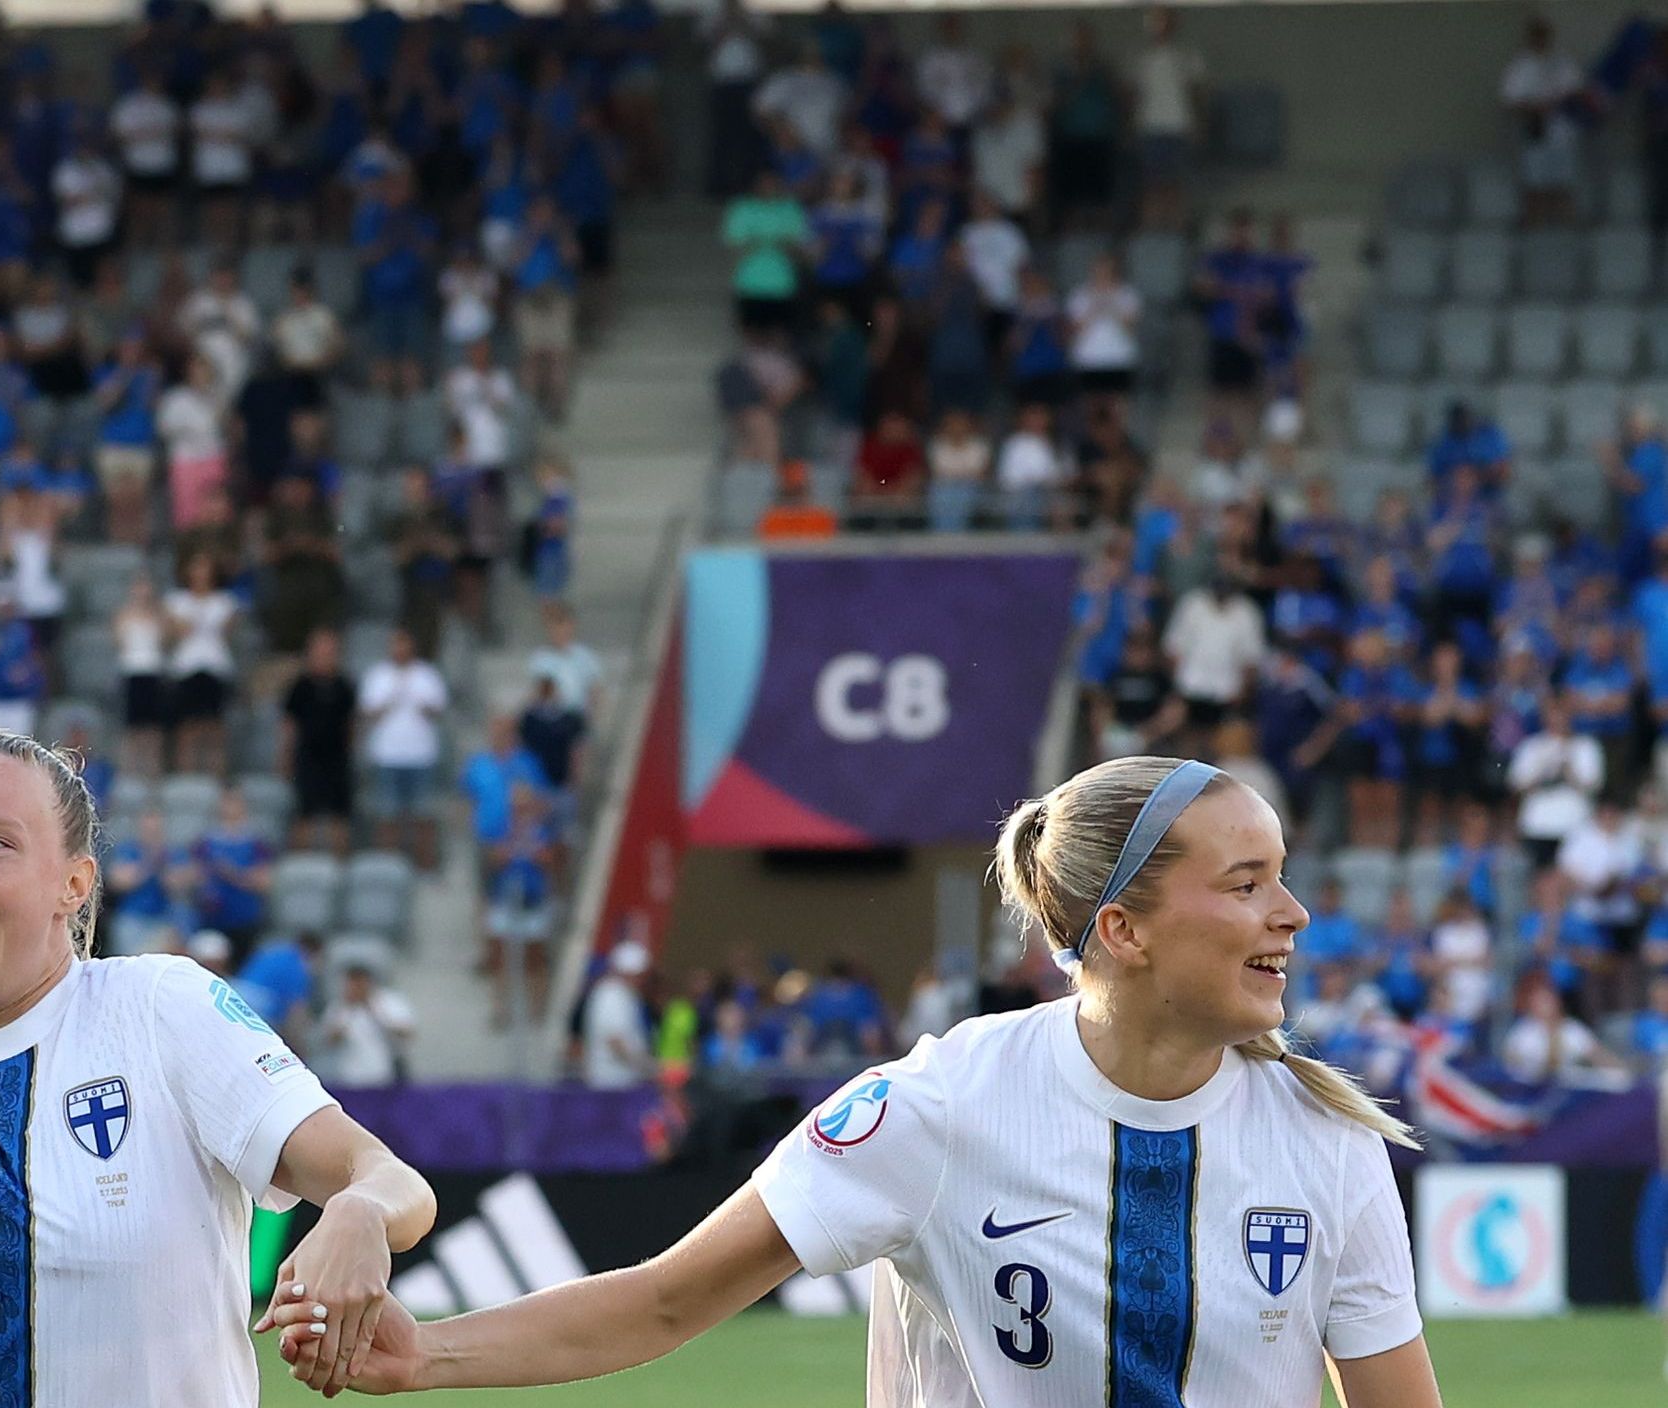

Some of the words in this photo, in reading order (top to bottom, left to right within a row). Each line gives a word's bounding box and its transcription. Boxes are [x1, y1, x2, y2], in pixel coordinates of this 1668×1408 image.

[814, 651, 951, 743] C8
[73, 1085, 116, 1101] SUOMI
[95, 1173, 129, 1185] ICELAND
[1255, 1216, 1301, 1226] SUOMI
[993, 1263, 1054, 1370] 3
